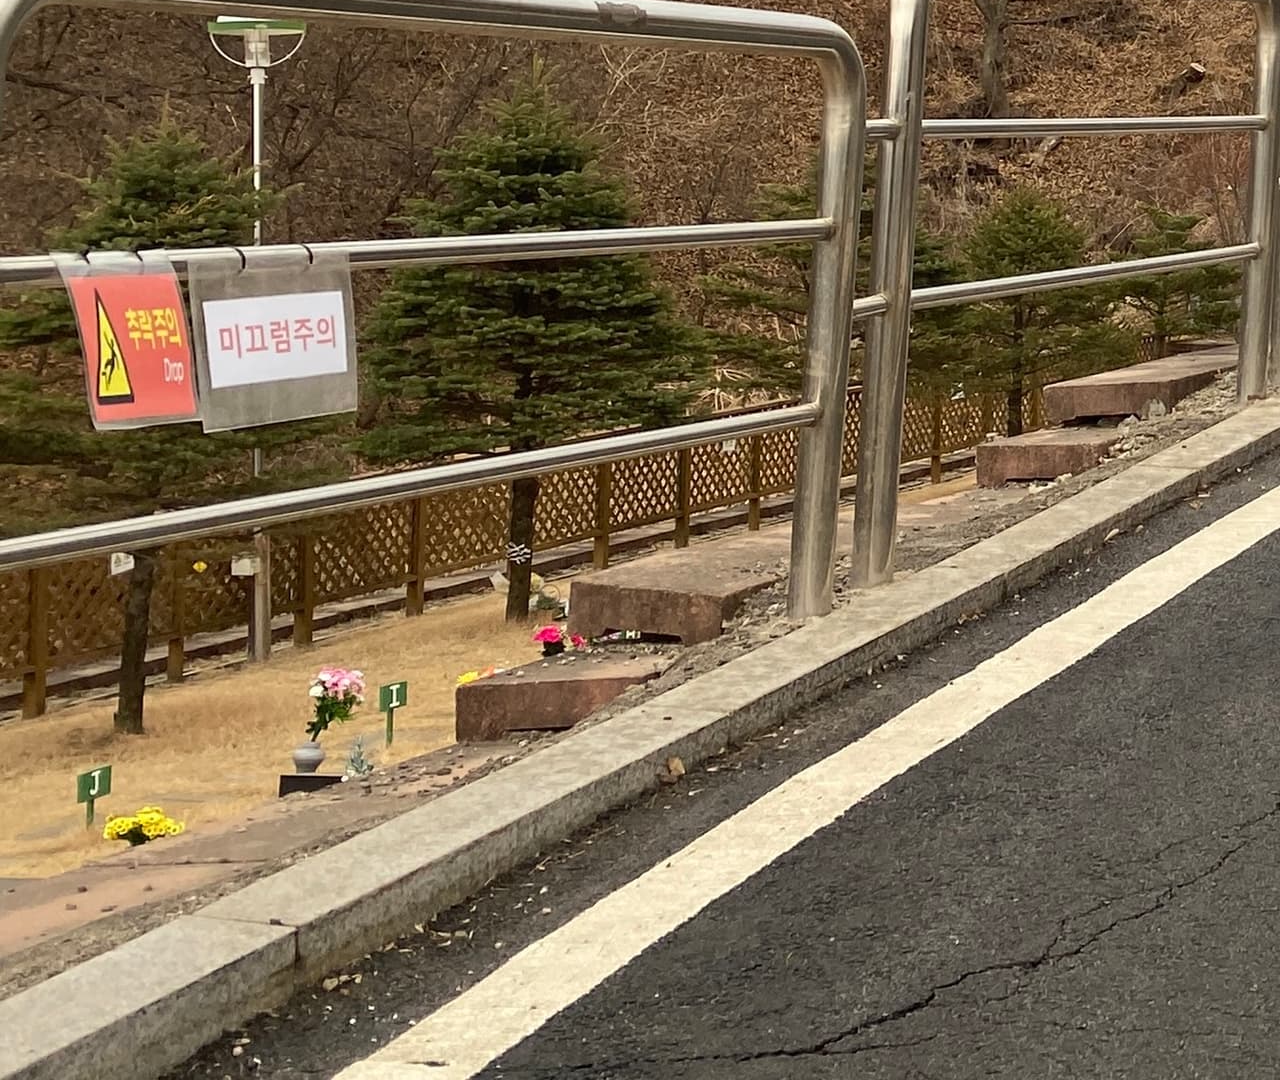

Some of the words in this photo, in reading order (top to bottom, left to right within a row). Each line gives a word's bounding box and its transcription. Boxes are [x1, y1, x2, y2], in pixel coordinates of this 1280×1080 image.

[125, 306, 182, 351] 추락주의
[219, 315, 336, 359] 미끄럼주의
[163, 357, 184, 385] Drop
[89, 770, 101, 795] J
